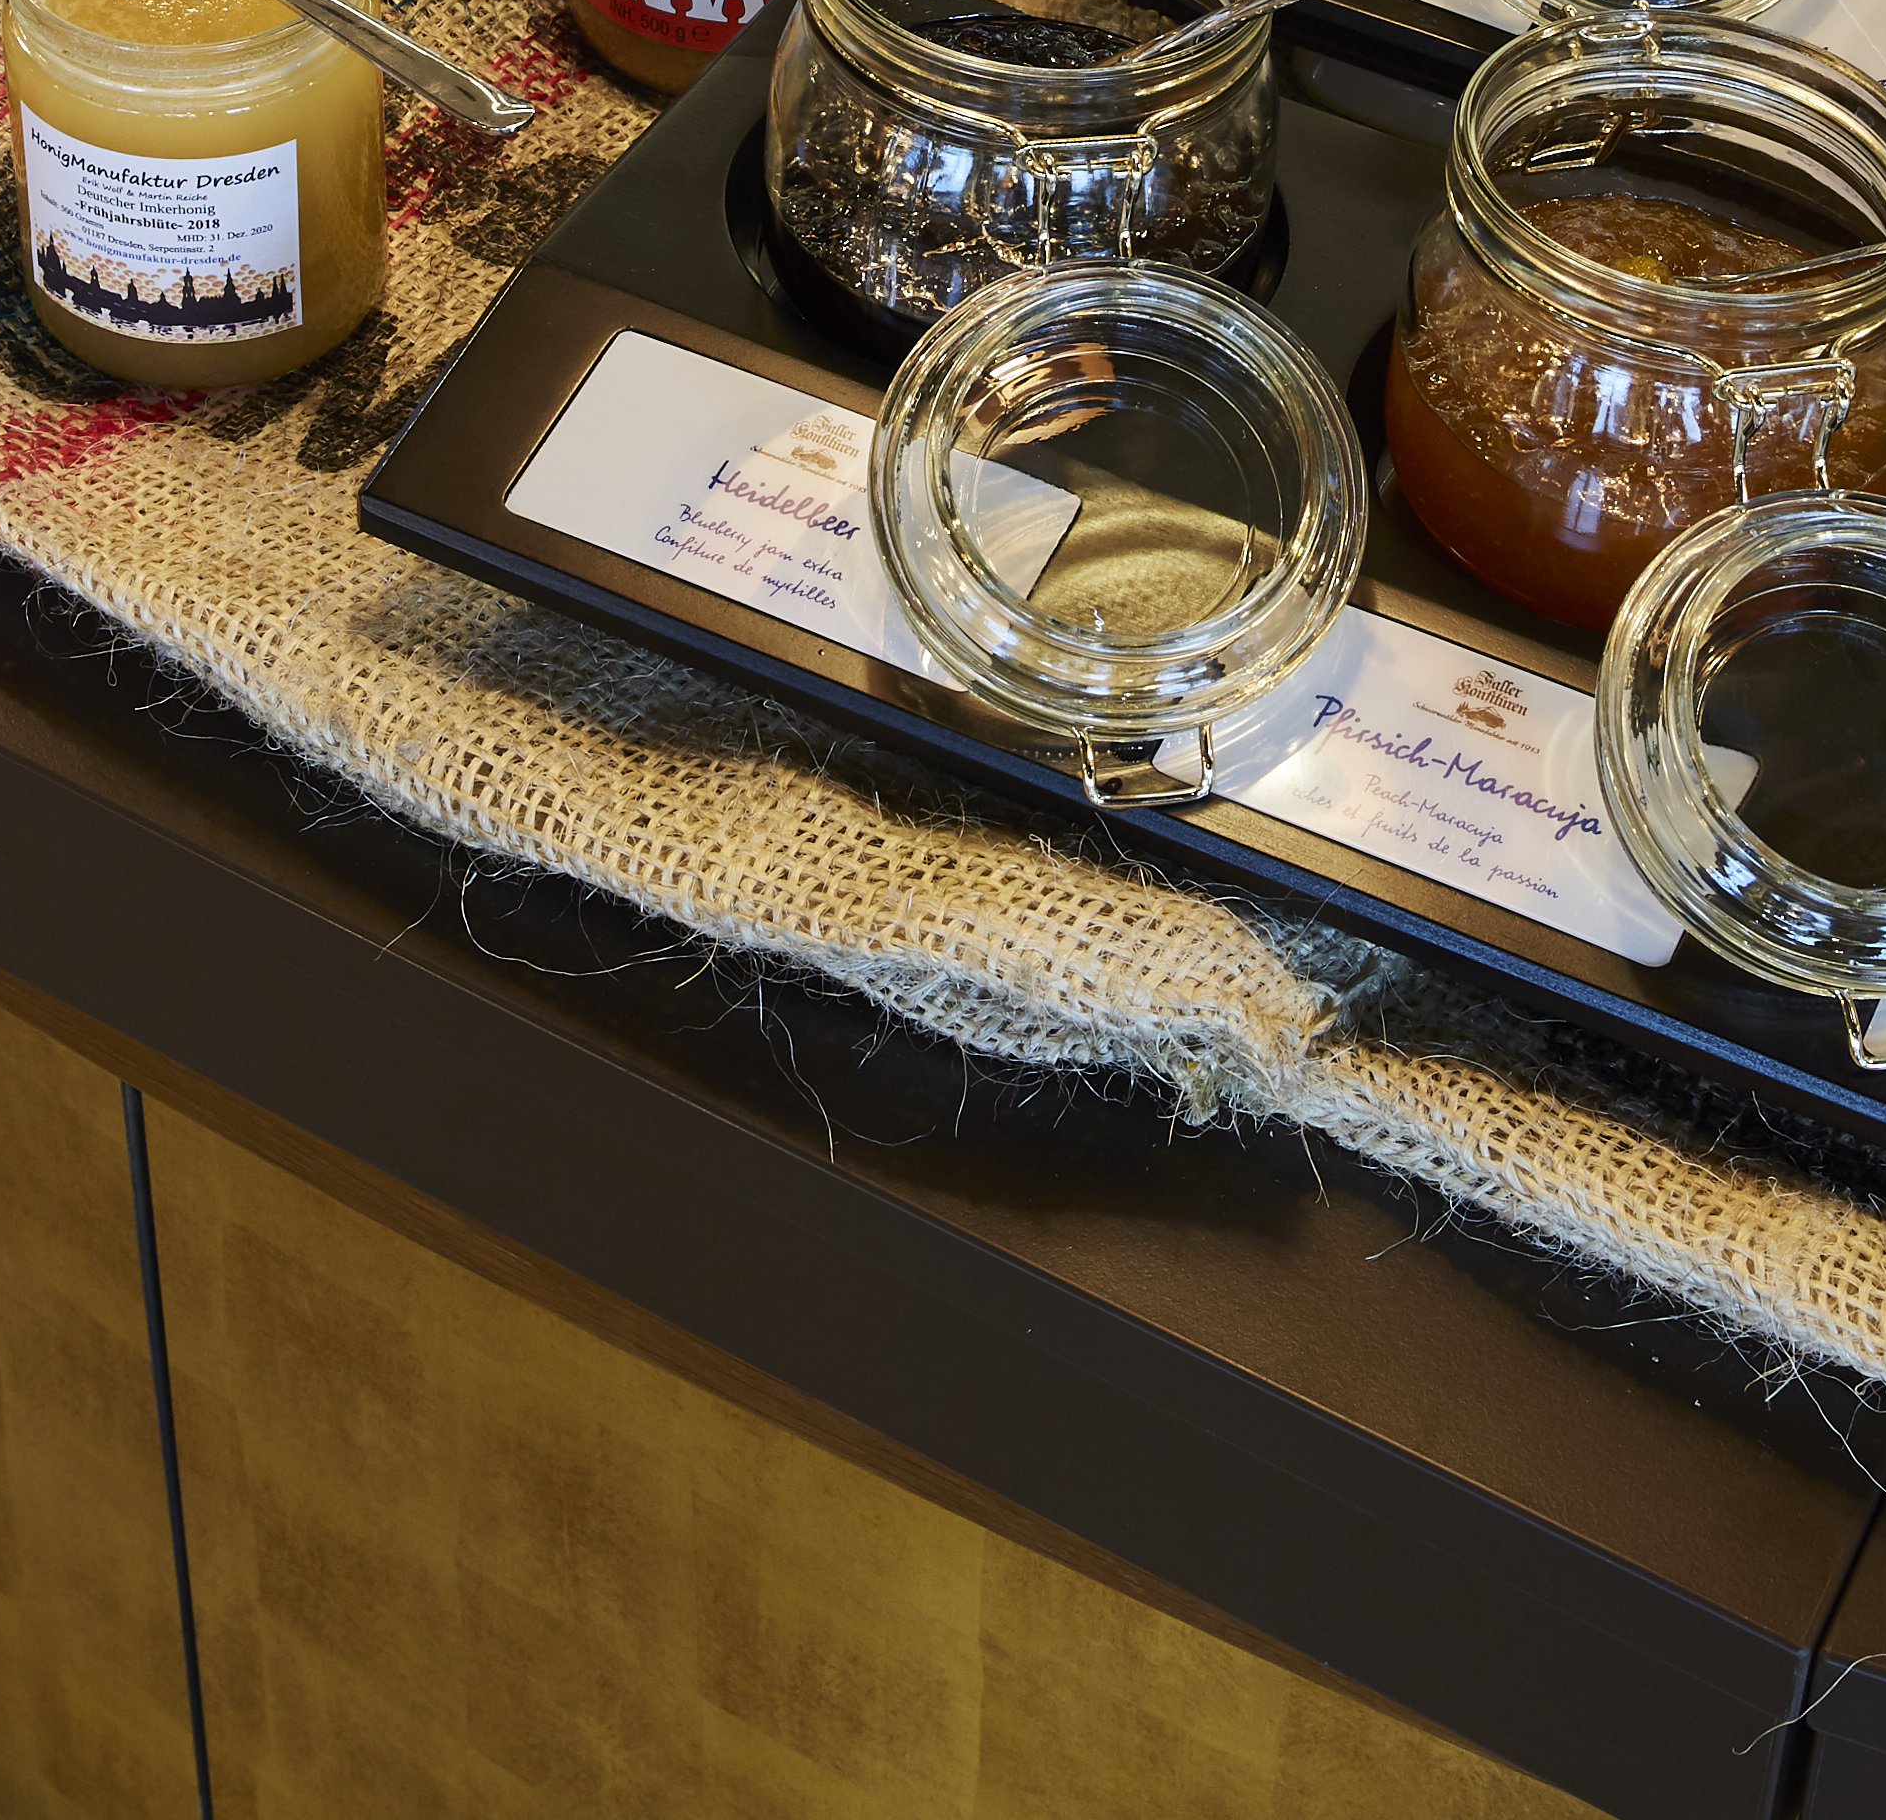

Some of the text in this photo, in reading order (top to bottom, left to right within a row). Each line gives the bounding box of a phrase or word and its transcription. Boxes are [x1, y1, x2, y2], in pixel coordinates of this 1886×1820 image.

[640, 16, 671, 38] 500
[676, 24, 687, 42] g
[31, 127, 280, 189] HonigManufaktur Dresden
[77, 184, 216, 217] Deutscher Imkerhonig
[81, 176, 100, 188] Erik
[138, 191, 173, 201] Martin
[176, 192, 208, 202] Reiche
[187, 218, 221, 230] 2018
[249, 223, 273, 236] 2020
[707, 459, 861, 541] Heidelbeer
[654, 525, 837, 610] Confiture de myrtilles
[679, 503, 844, 581] Blueberry jam extra
[1452, 675, 1529, 717] Konfitüren
[1474, 669, 1524, 699] Faller
[1314, 693, 1603, 842] Pfirsich-Maracuja
[1364, 772, 1505, 848] Peach-Maracuja
[1426, 833, 1451, 856] de
[1457, 847, 1482, 868] la
[1487, 863, 1560, 900] passion
